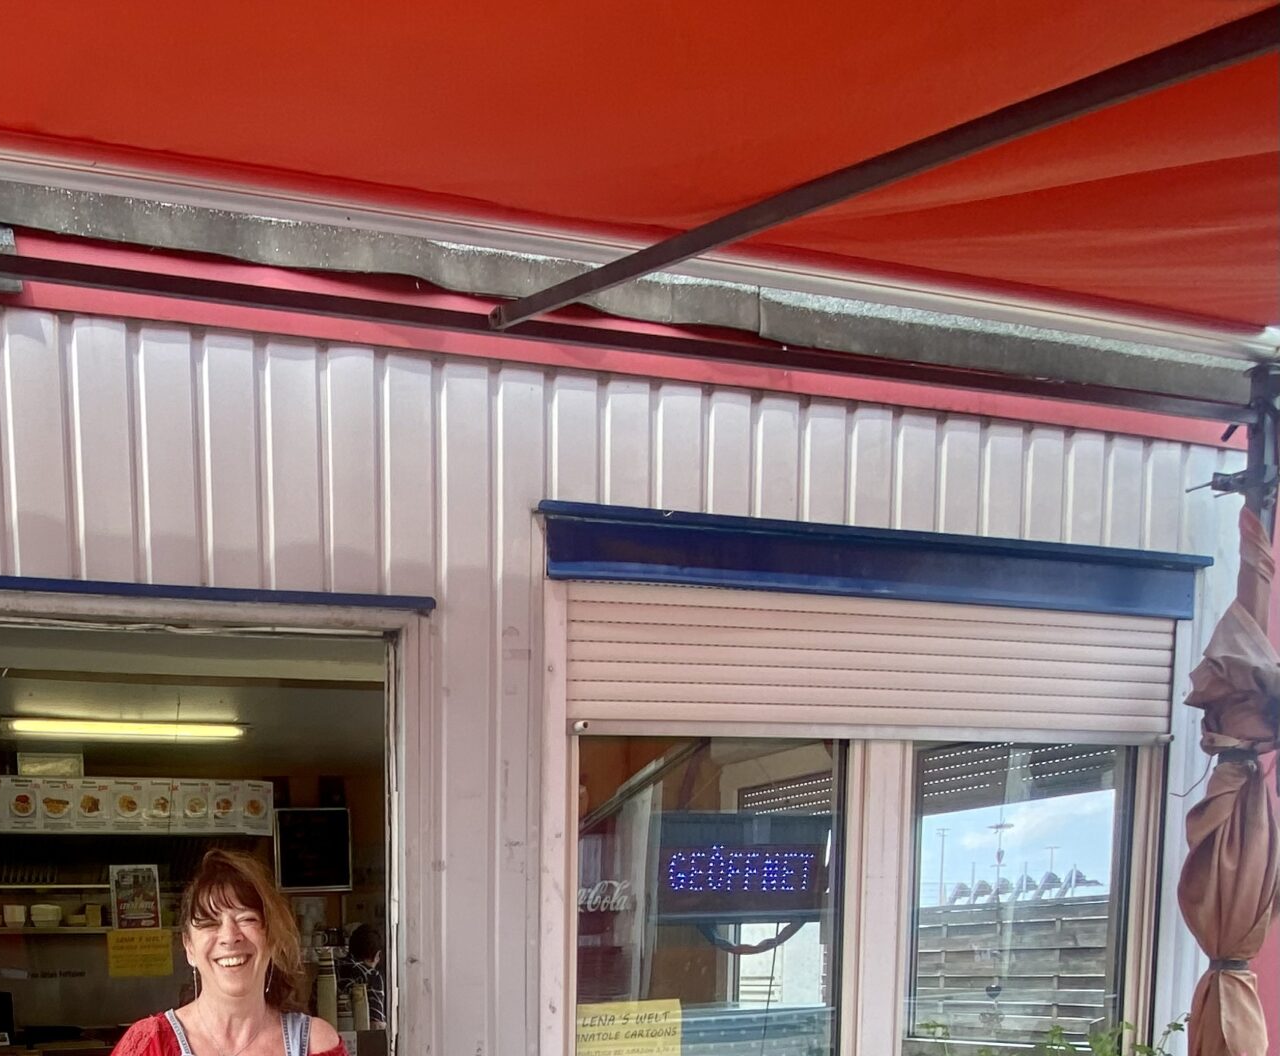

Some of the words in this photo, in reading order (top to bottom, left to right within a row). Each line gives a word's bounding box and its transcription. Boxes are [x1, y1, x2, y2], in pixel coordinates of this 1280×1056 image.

[668, 845, 815, 892] GEÖFFNET
[581, 1014, 616, 1028] LENA
[636, 1011, 671, 1025] WELT
[624, 1027, 678, 1040] CARTOONS
